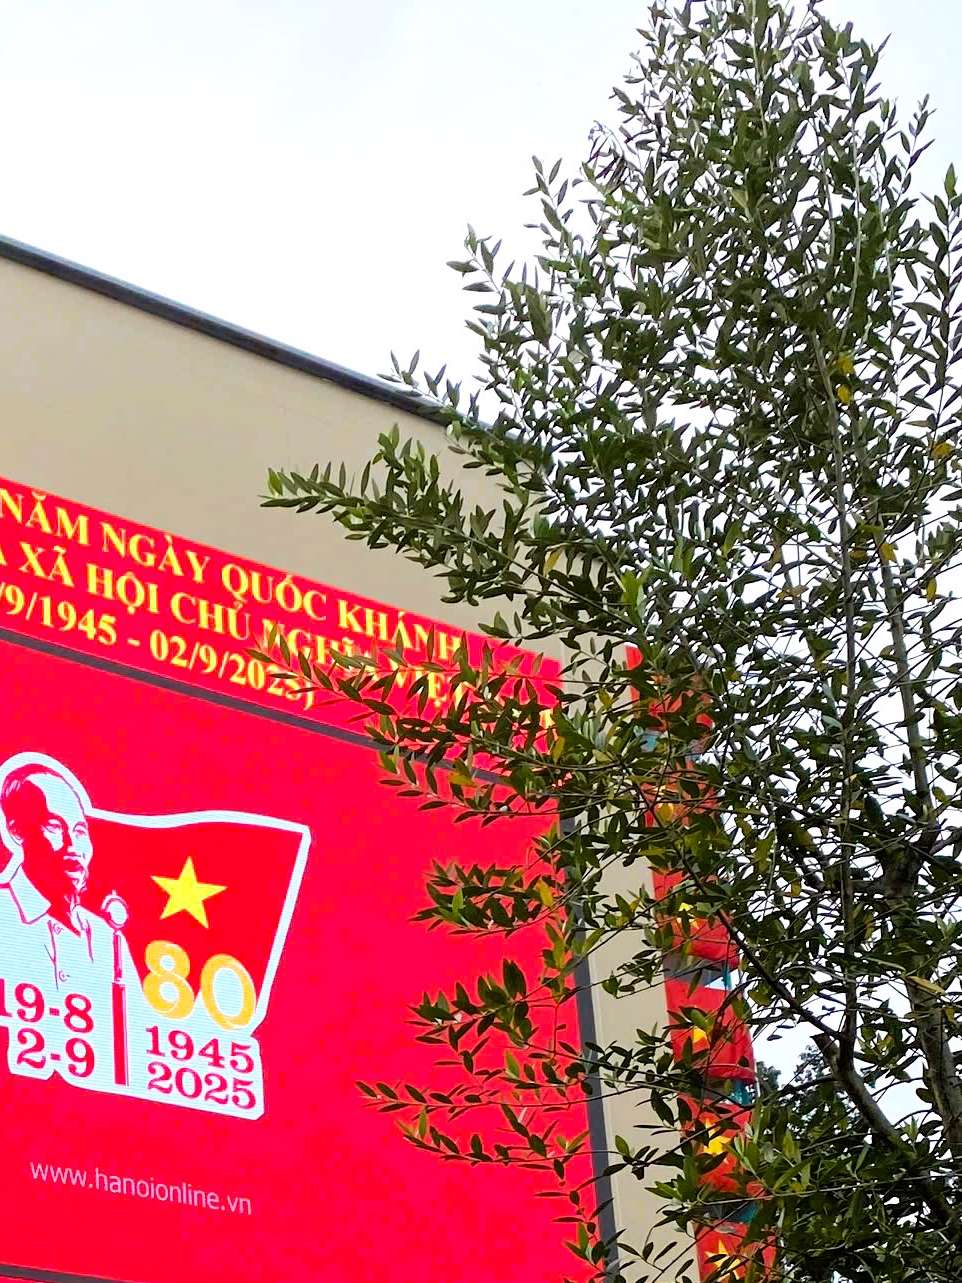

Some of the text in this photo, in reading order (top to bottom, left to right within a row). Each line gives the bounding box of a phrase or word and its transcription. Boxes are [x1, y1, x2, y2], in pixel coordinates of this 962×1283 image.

[20, 543, 76, 589] XÃ
[86, 563, 159, 616] HỘI
[170, 590, 252, 642] CHỦ
[101, 521, 211, 584] NGÀY
[221, 563, 327, 621] QUỐC
[338, 601, 465, 661] KHÁNH
[126, 637, 142, 648] -
[142, 940, 257, 1031] 80
[16, 1028, 96, 1079] 2-9
[145, 1025, 255, 1075] 1945
[146, 1061, 257, 1111] 2025
[29, 1161, 253, 1215] www.hanoionline.vn
